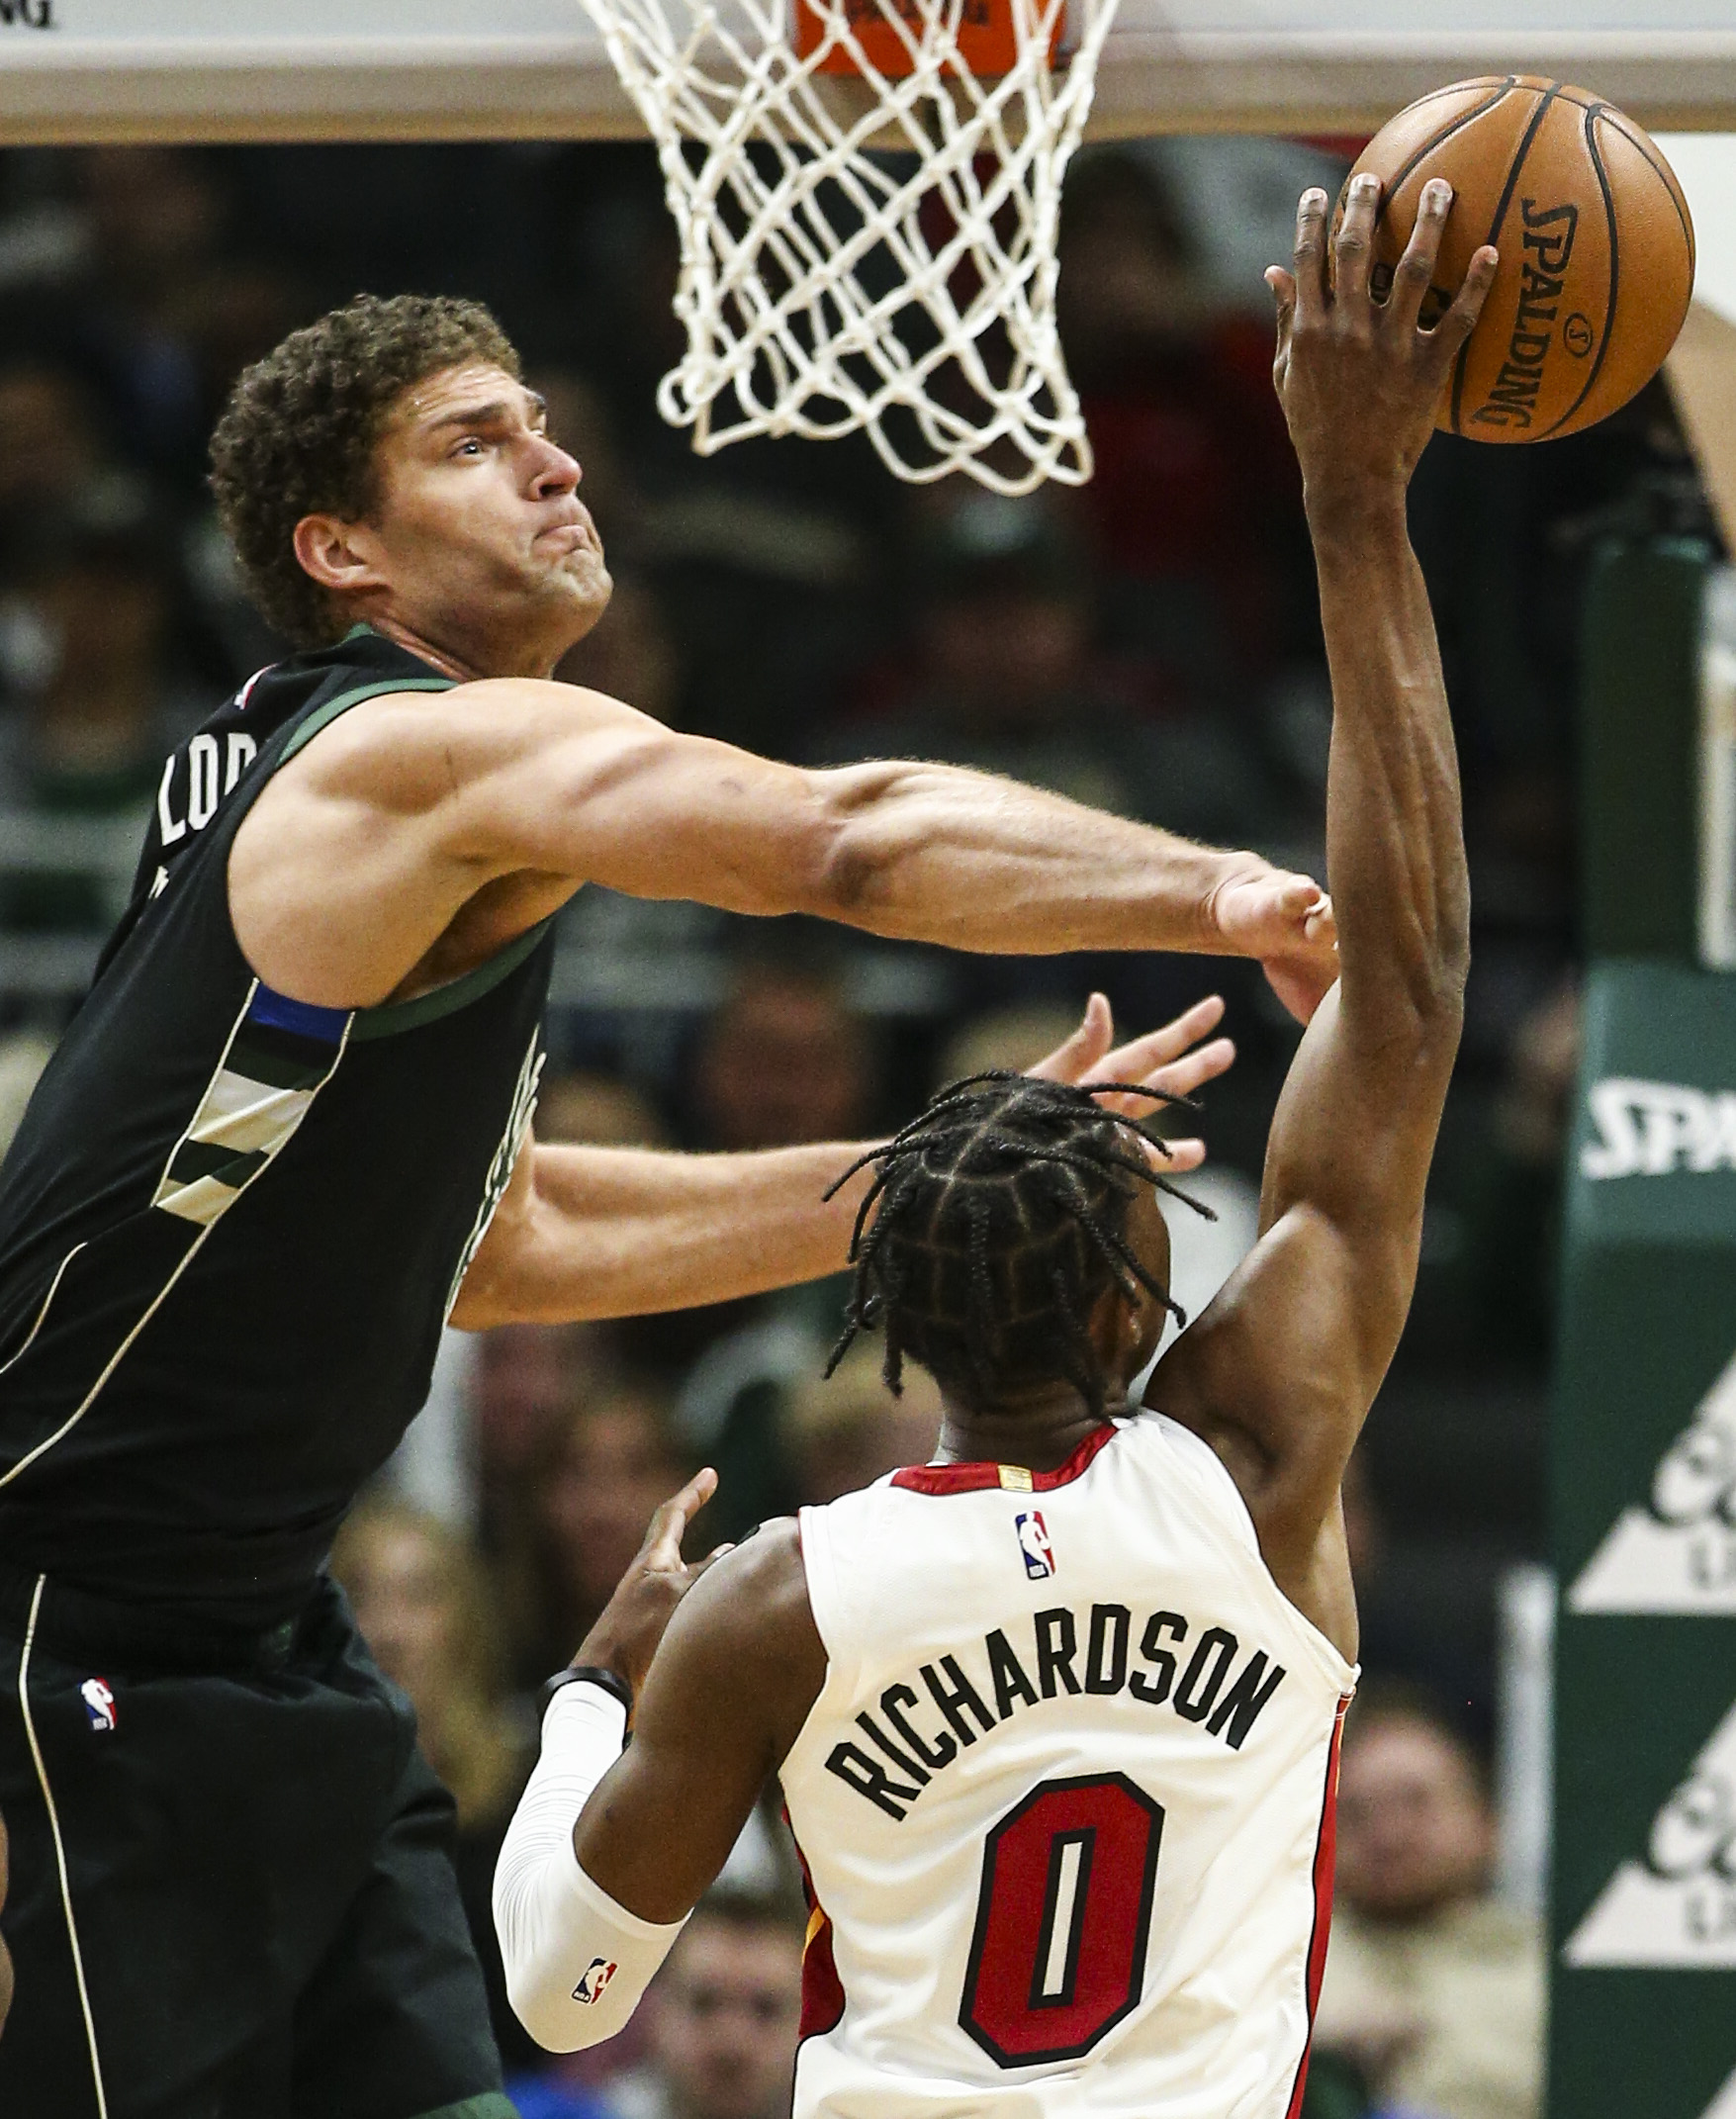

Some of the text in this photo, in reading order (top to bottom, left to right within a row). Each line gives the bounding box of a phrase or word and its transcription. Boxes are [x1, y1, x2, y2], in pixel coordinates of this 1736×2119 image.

[1472, 198, 1578, 427] SPALDING
[824, 1603, 1287, 1822] RICHARDSON
[958, 1771, 1165, 2070] 0
